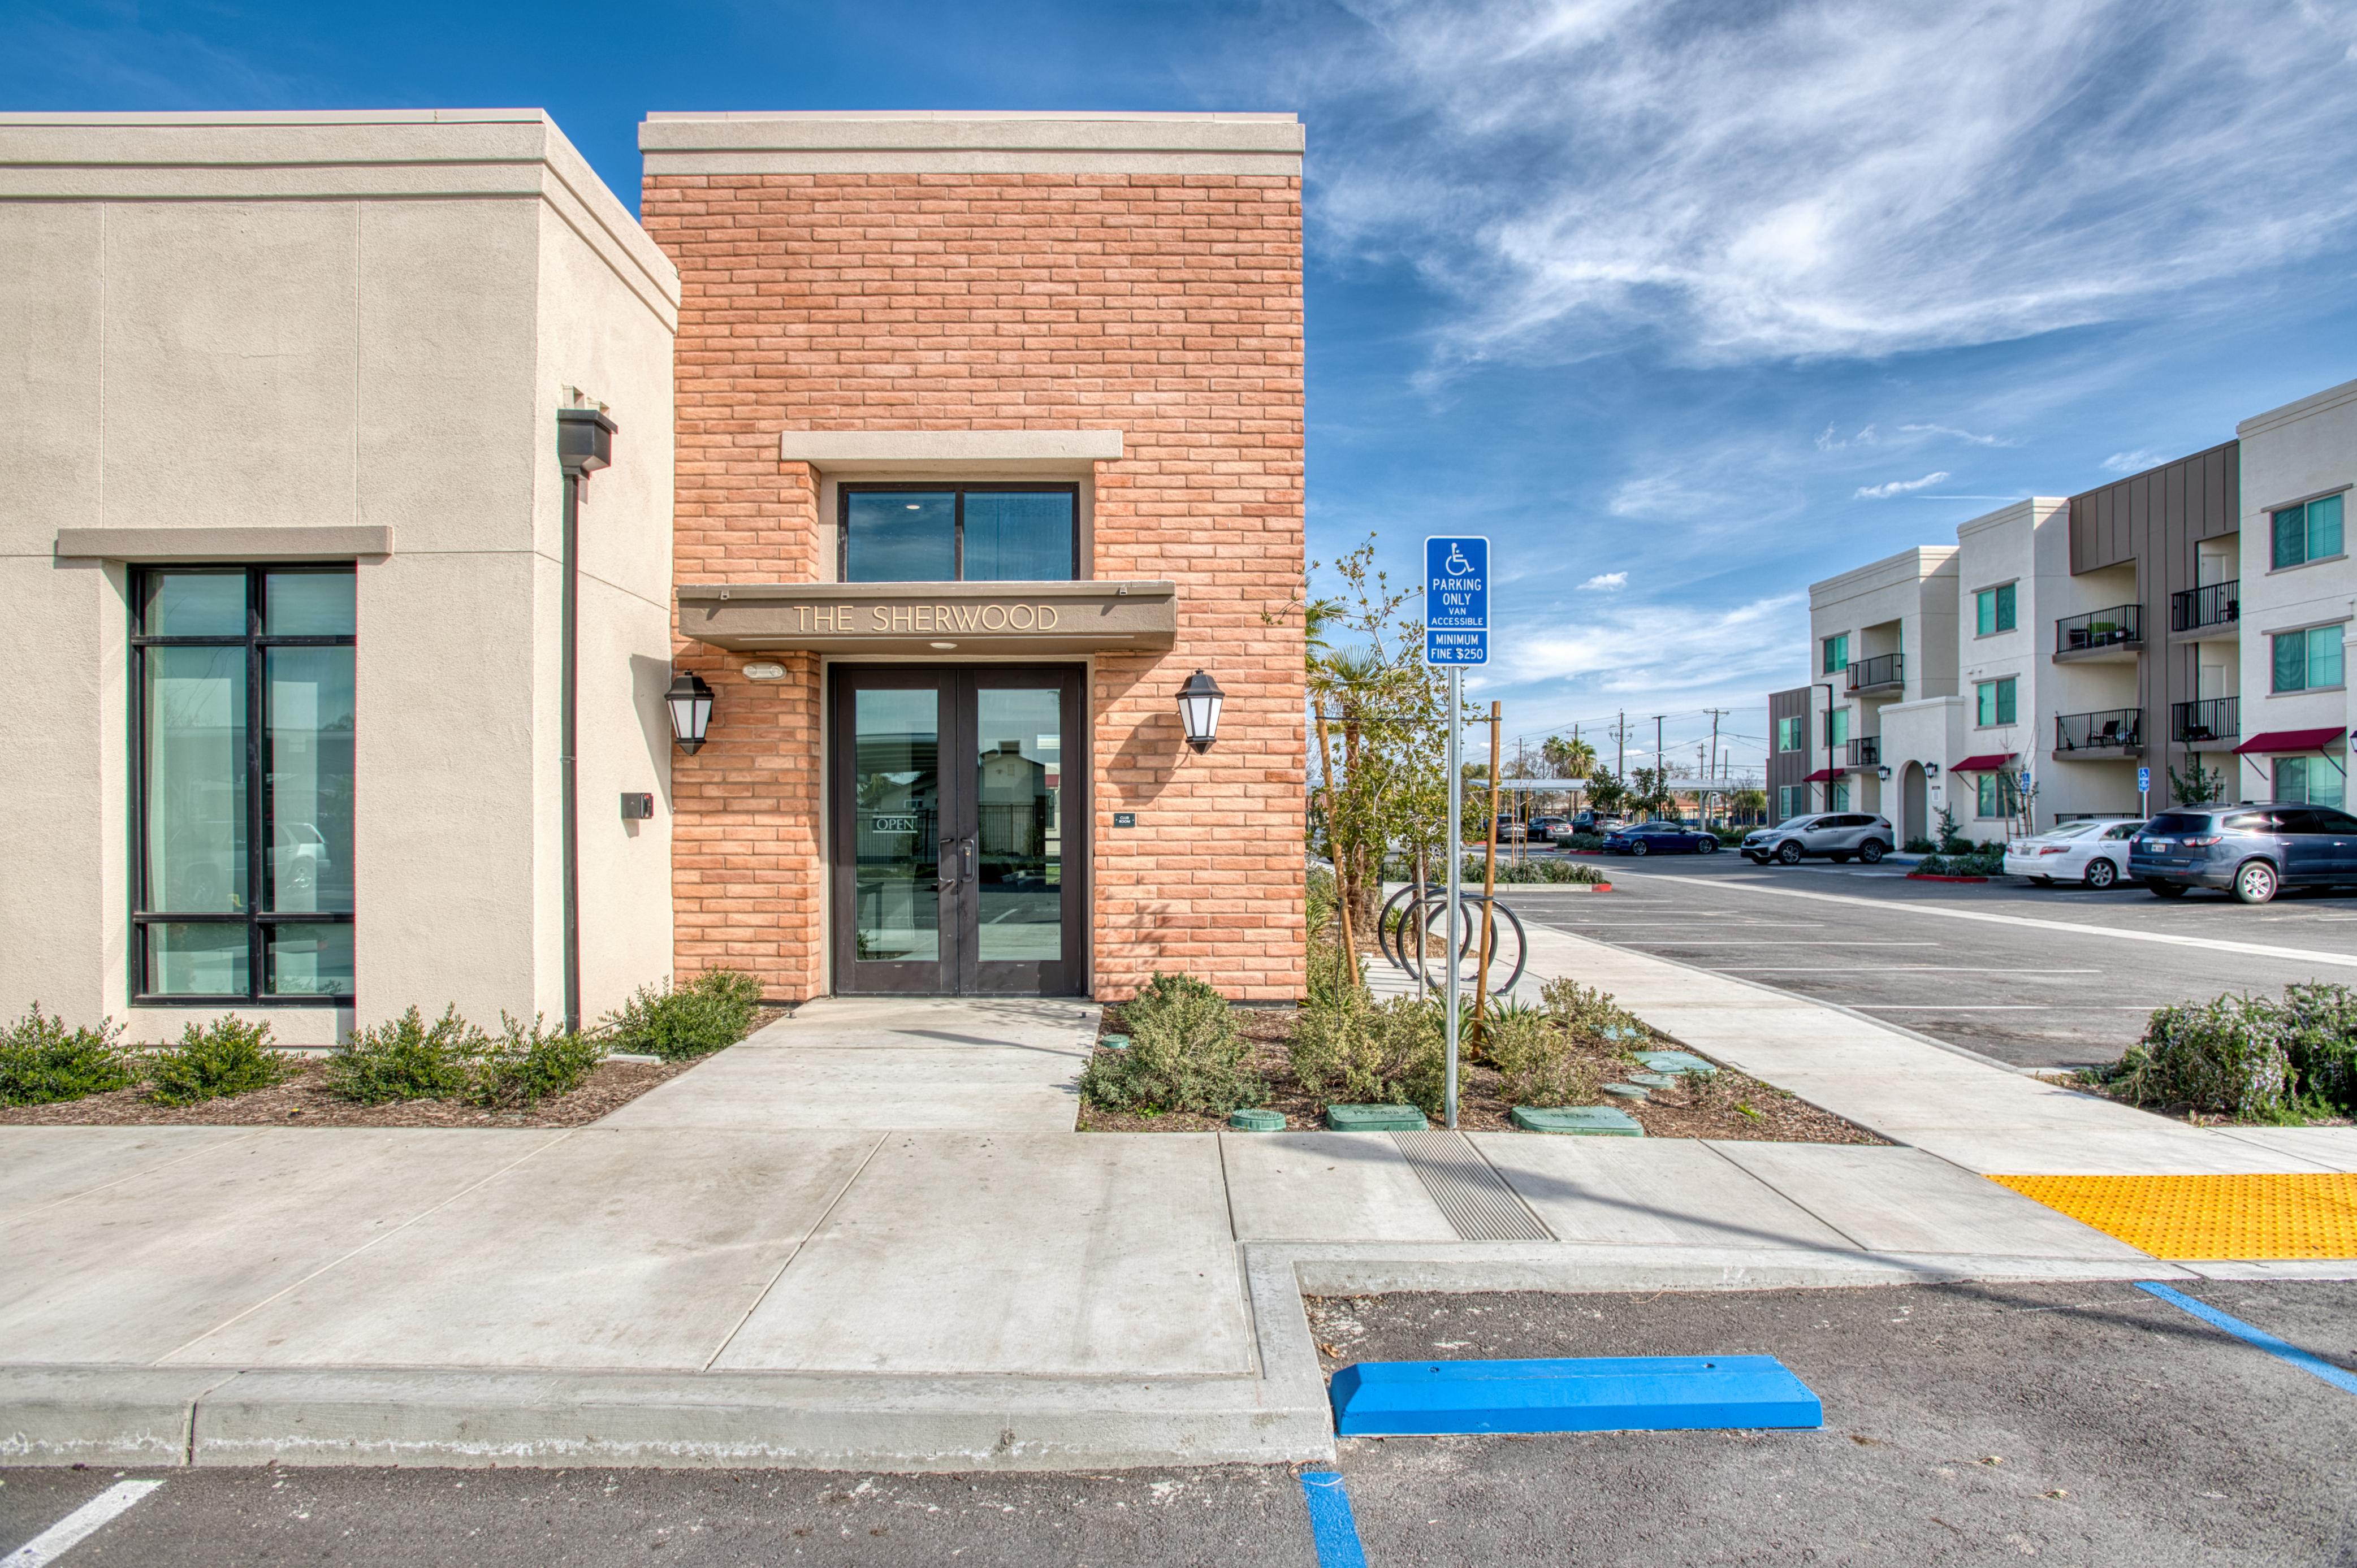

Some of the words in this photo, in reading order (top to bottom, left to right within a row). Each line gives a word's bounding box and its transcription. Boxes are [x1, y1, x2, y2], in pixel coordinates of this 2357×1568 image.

[1433, 578, 1481, 591] PARKING
[1443, 593, 1471, 605] ONLY
[793, 605, 854, 631] THE
[872, 604, 1058, 631] SHERWOOD
[1448, 607, 1467, 616] VAN
[1432, 617, 1484, 626] ACCESSIBLE
[1436, 634, 1478, 645] MINIMUM
[1431, 648, 1452, 659] FINE
[1456, 648, 1484, 660] $250
[876, 818, 914, 830] OPEN
